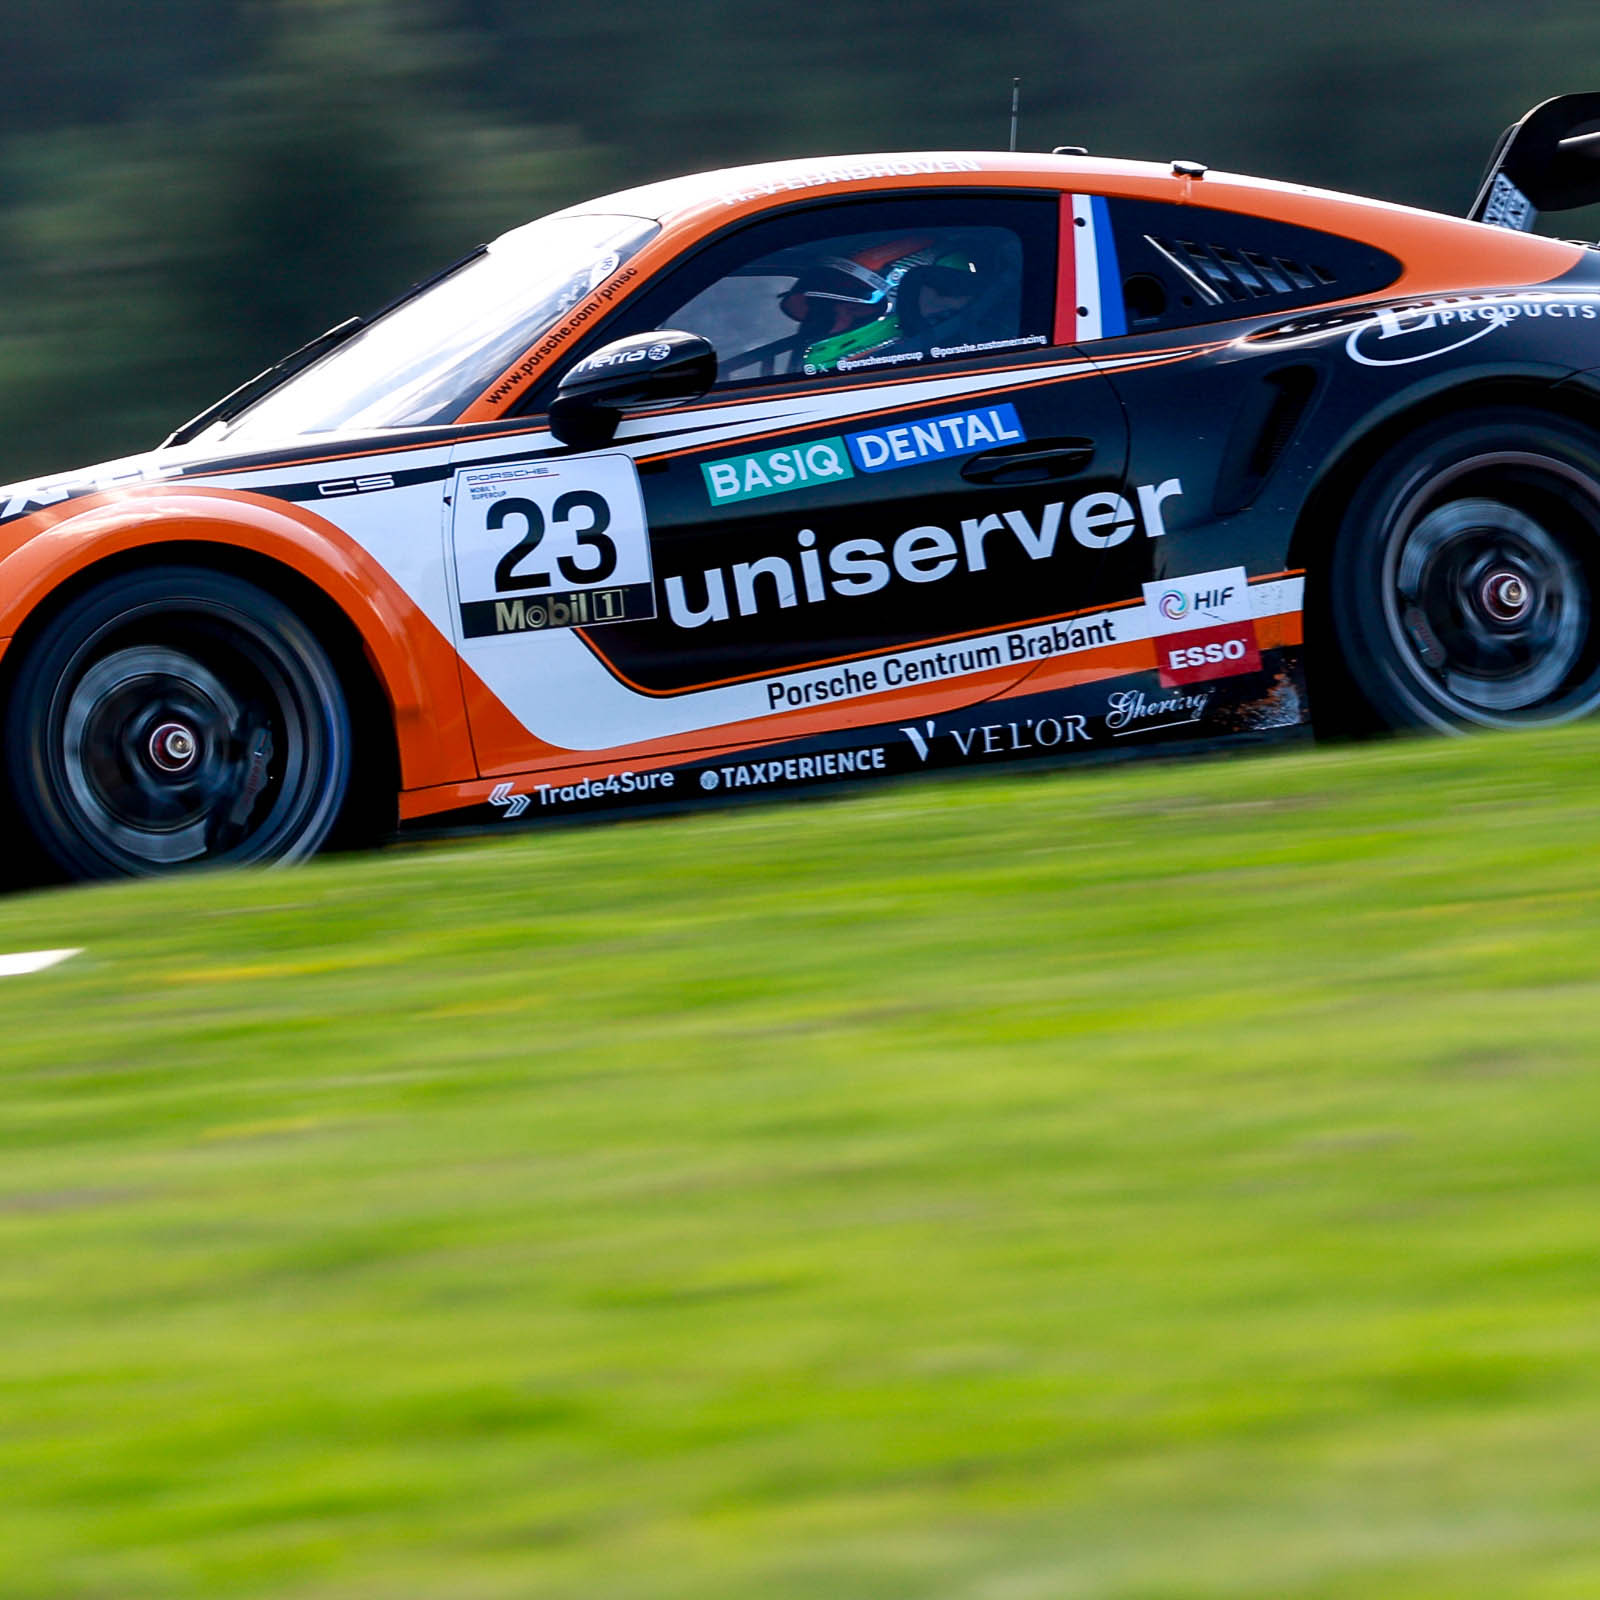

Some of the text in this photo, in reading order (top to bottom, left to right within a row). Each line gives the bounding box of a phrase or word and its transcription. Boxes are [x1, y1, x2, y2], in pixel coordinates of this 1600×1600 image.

[1440, 303, 1597, 326] PRODUCTS
[486, 267, 639, 405] www.porsche.com/pmsc
[709, 410, 1020, 499] BASIQ DENTAL
[317, 474, 395, 495] CS
[466, 467, 550, 482] PORSCHE
[486, 490, 618, 593] 23
[664, 478, 1184, 629] uniserver
[495, 593, 589, 632] Mobil
[1193, 586, 1235, 611] HIF
[767, 618, 1117, 710] Porsche Centrum Brabant
[1168, 639, 1247, 670] ESSO
[950, 714, 1094, 756] VEL'OR
[720, 748, 886, 788] TAXPERIENCE
[534, 770, 675, 806] Trade4Sure
